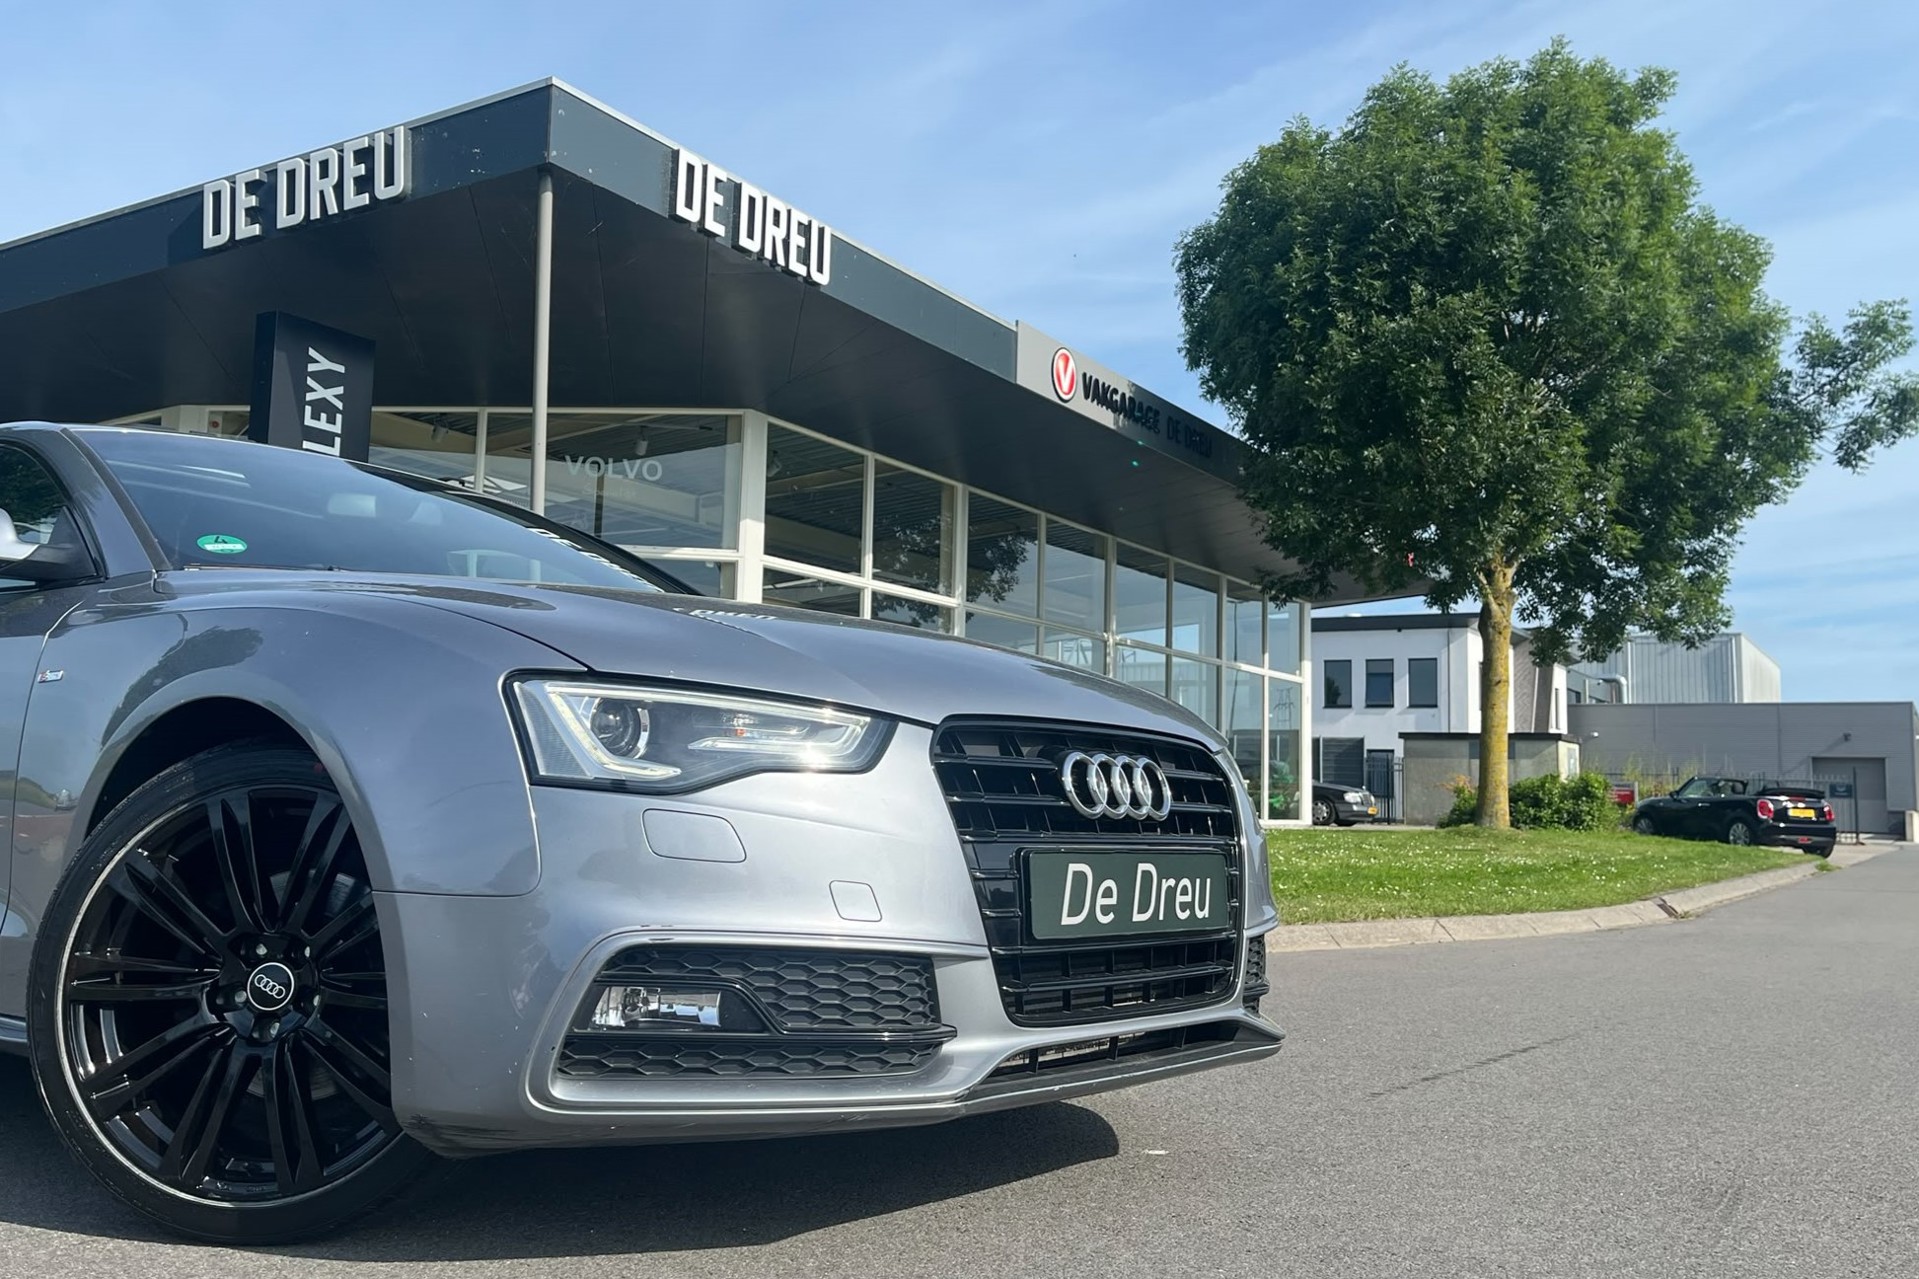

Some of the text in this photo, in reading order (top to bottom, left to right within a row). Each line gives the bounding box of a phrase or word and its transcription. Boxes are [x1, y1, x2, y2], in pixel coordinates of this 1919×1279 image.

[203, 125, 405, 250] DE DREU
[676, 148, 832, 285] DE DREU
[1081, 371, 1161, 435] VAKGARAGE
[1166, 416, 1181, 445] DE
[564, 455, 663, 482] VOLVO
[1061, 862, 1211, 926] De Dreu
